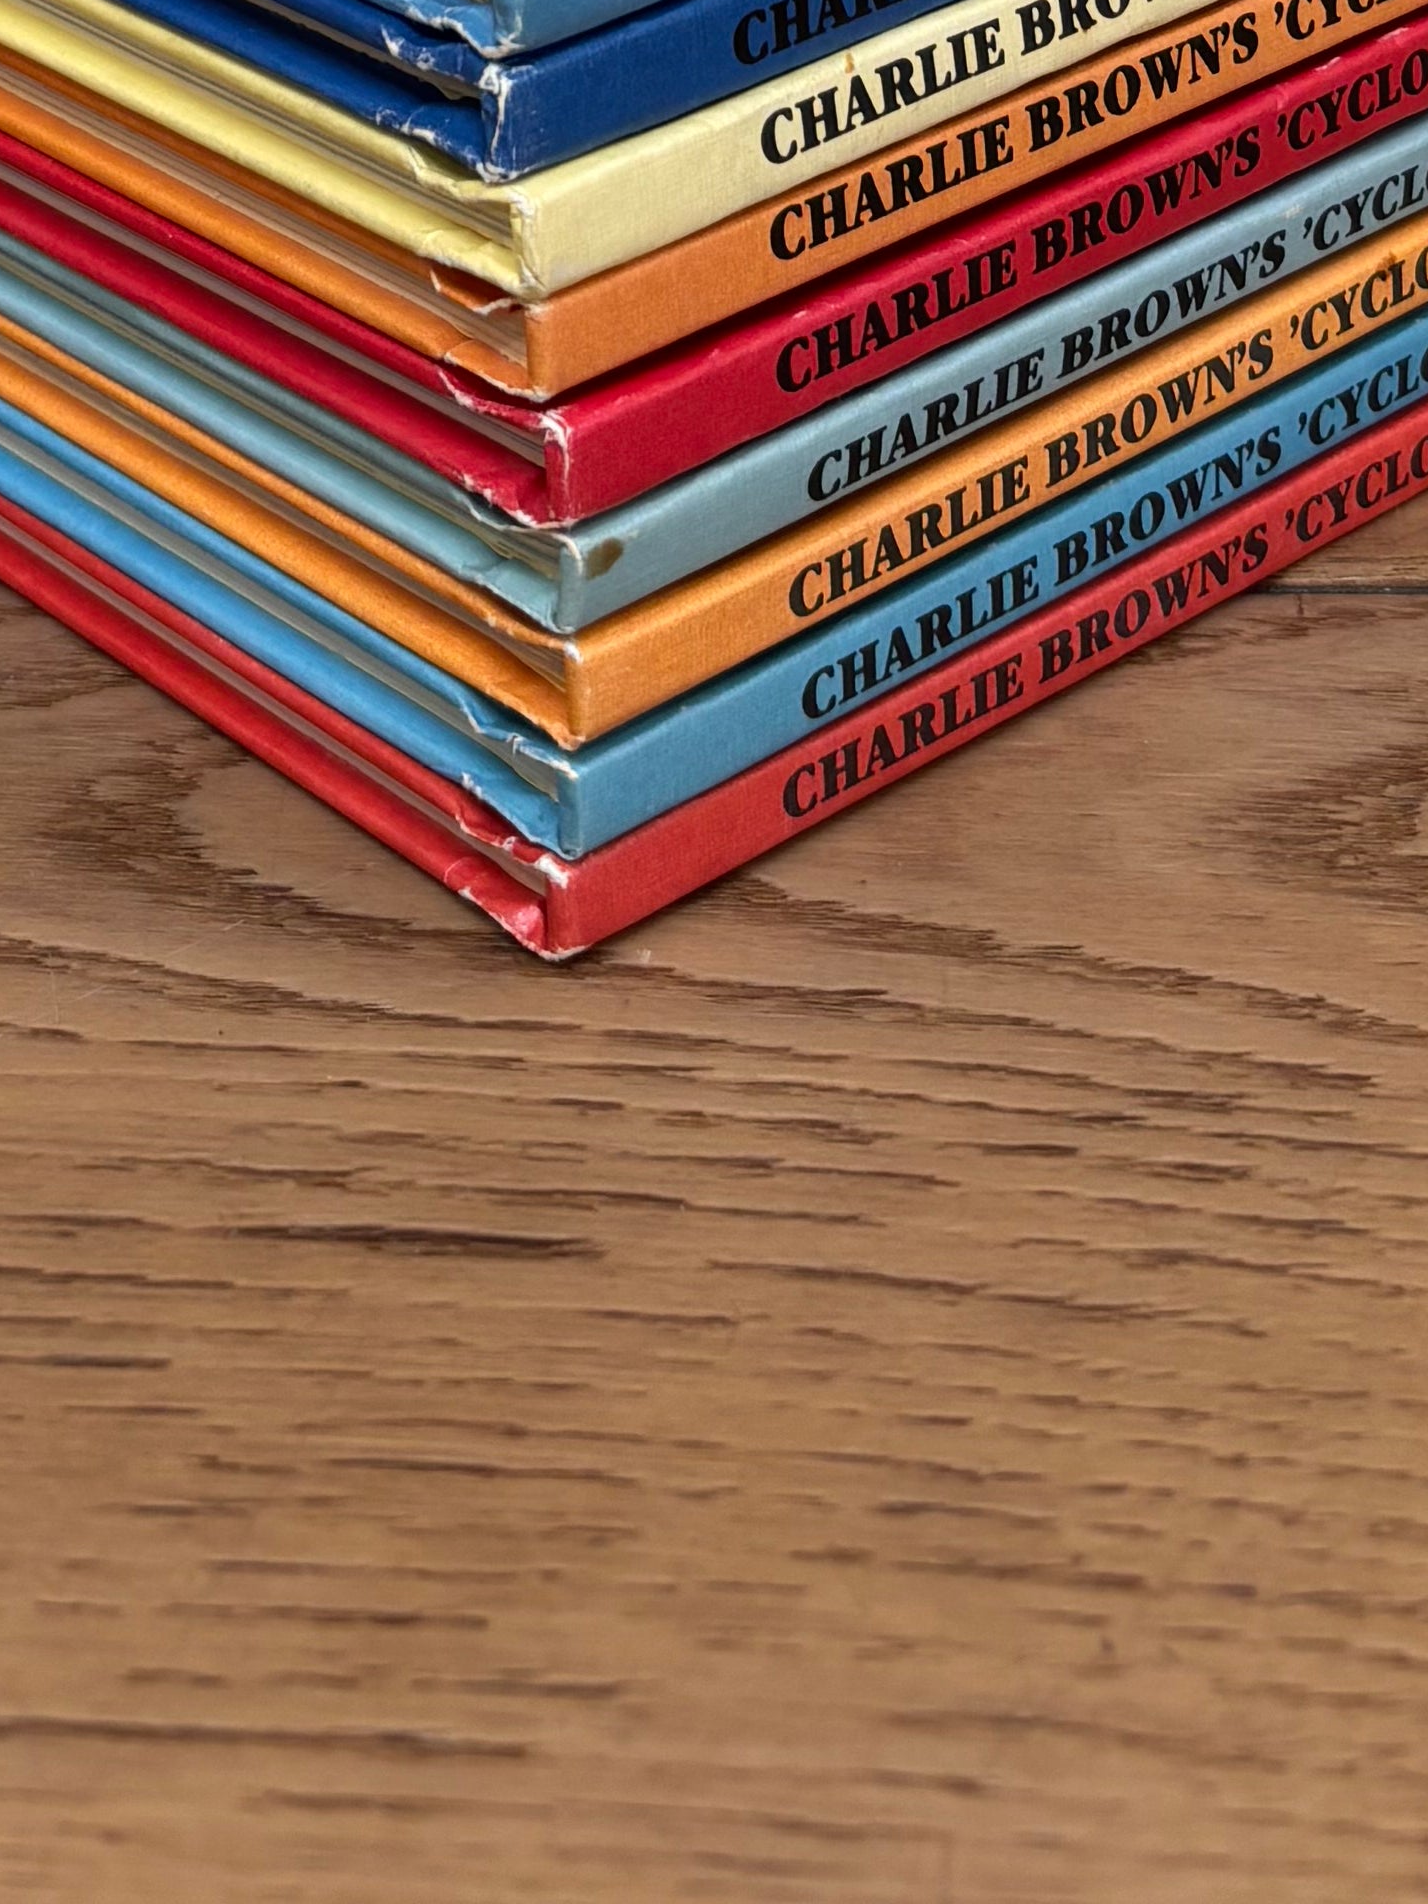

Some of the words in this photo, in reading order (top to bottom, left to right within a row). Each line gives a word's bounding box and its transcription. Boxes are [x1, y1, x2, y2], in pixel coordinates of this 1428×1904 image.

[761, 18, 1004, 163] CHARLIE
[770, 116, 1012, 260] CHARLIE
[1025, 13, 1257, 151] BROWN'S
[776, 240, 1016, 392] CHARLIE
[1031, 126, 1259, 273] BROWN'S
[807, 348, 1043, 501] CHARLIE
[1058, 230, 1285, 378] BROWN'S
[789, 456, 1029, 617] CHARLIE
[1044, 329, 1272, 487] BROWN'S
[802, 556, 1038, 719] CHARLIE
[1054, 426, 1280, 585] BROWN'S
[782, 654, 1023, 817] CHARLIE
[1038, 524, 1267, 683] BROWN'S
